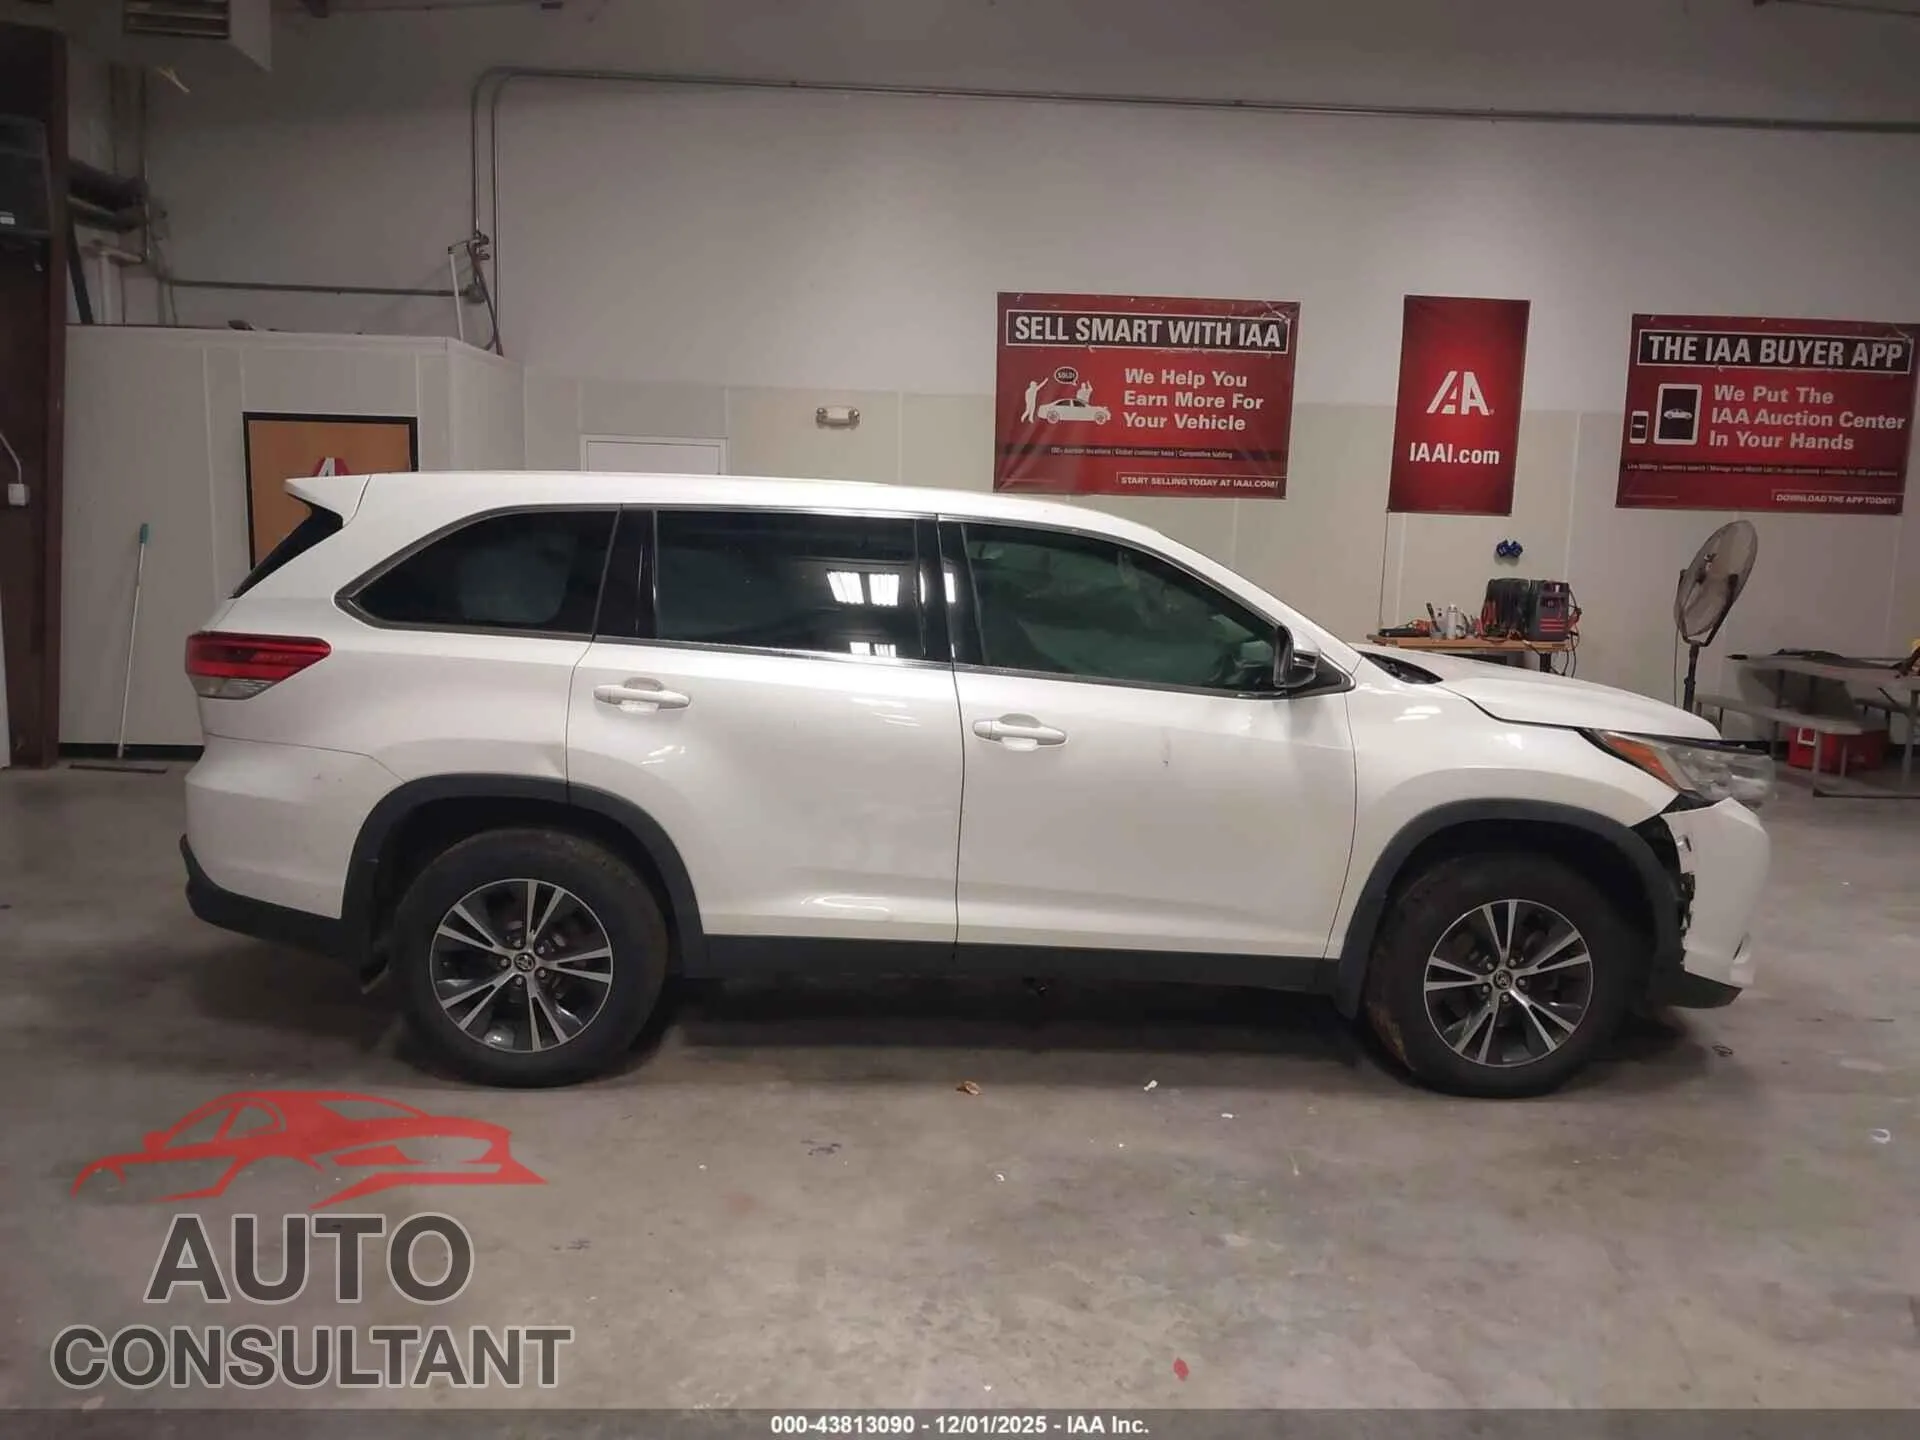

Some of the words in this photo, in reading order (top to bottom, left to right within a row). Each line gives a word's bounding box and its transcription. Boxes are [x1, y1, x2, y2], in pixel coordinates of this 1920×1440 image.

[1014, 315, 1069, 342] SELL
[1075, 317, 1163, 344] SMART
[1168, 320, 1231, 345] WITH
[1238, 323, 1281, 348] IAA
[1649, 335, 1698, 361] THE
[1705, 337, 1751, 363] IAA
[1759, 339, 1844, 366] BUYER
[1851, 342, 1903, 368] APP
[1125, 367, 1154, 385] We
[1161, 369, 1205, 388] Help
[1212, 371, 1248, 388] You
[1124, 390, 1167, 407] Earn
[1174, 391, 1225, 408] More
[1232, 393, 1264, 410] For
[1714, 385, 1745, 402] We
[1752, 386, 1788, 403] Put
[1796, 386, 1834, 404] The
[1124, 412, 1167, 429] Your
[1174, 414, 1246, 431] Vehicle
[1711, 408, 1751, 425] IAA
[1754, 409, 1833, 427] Auction
[1839, 411, 1906, 430] Center
[1709, 430, 1728, 447] In
[1736, 431, 1782, 448] Your
[1790, 433, 1854, 450] Hands
[1409, 442, 1500, 465] IAAI.com
[1120, 476, 1148, 485] START
[1151, 477, 1189, 486] SELLING
[1189, 478, 1217, 486] TODAY
[1219, 479, 1231, 487] AT
[1846, 495, 1865, 504] APP
